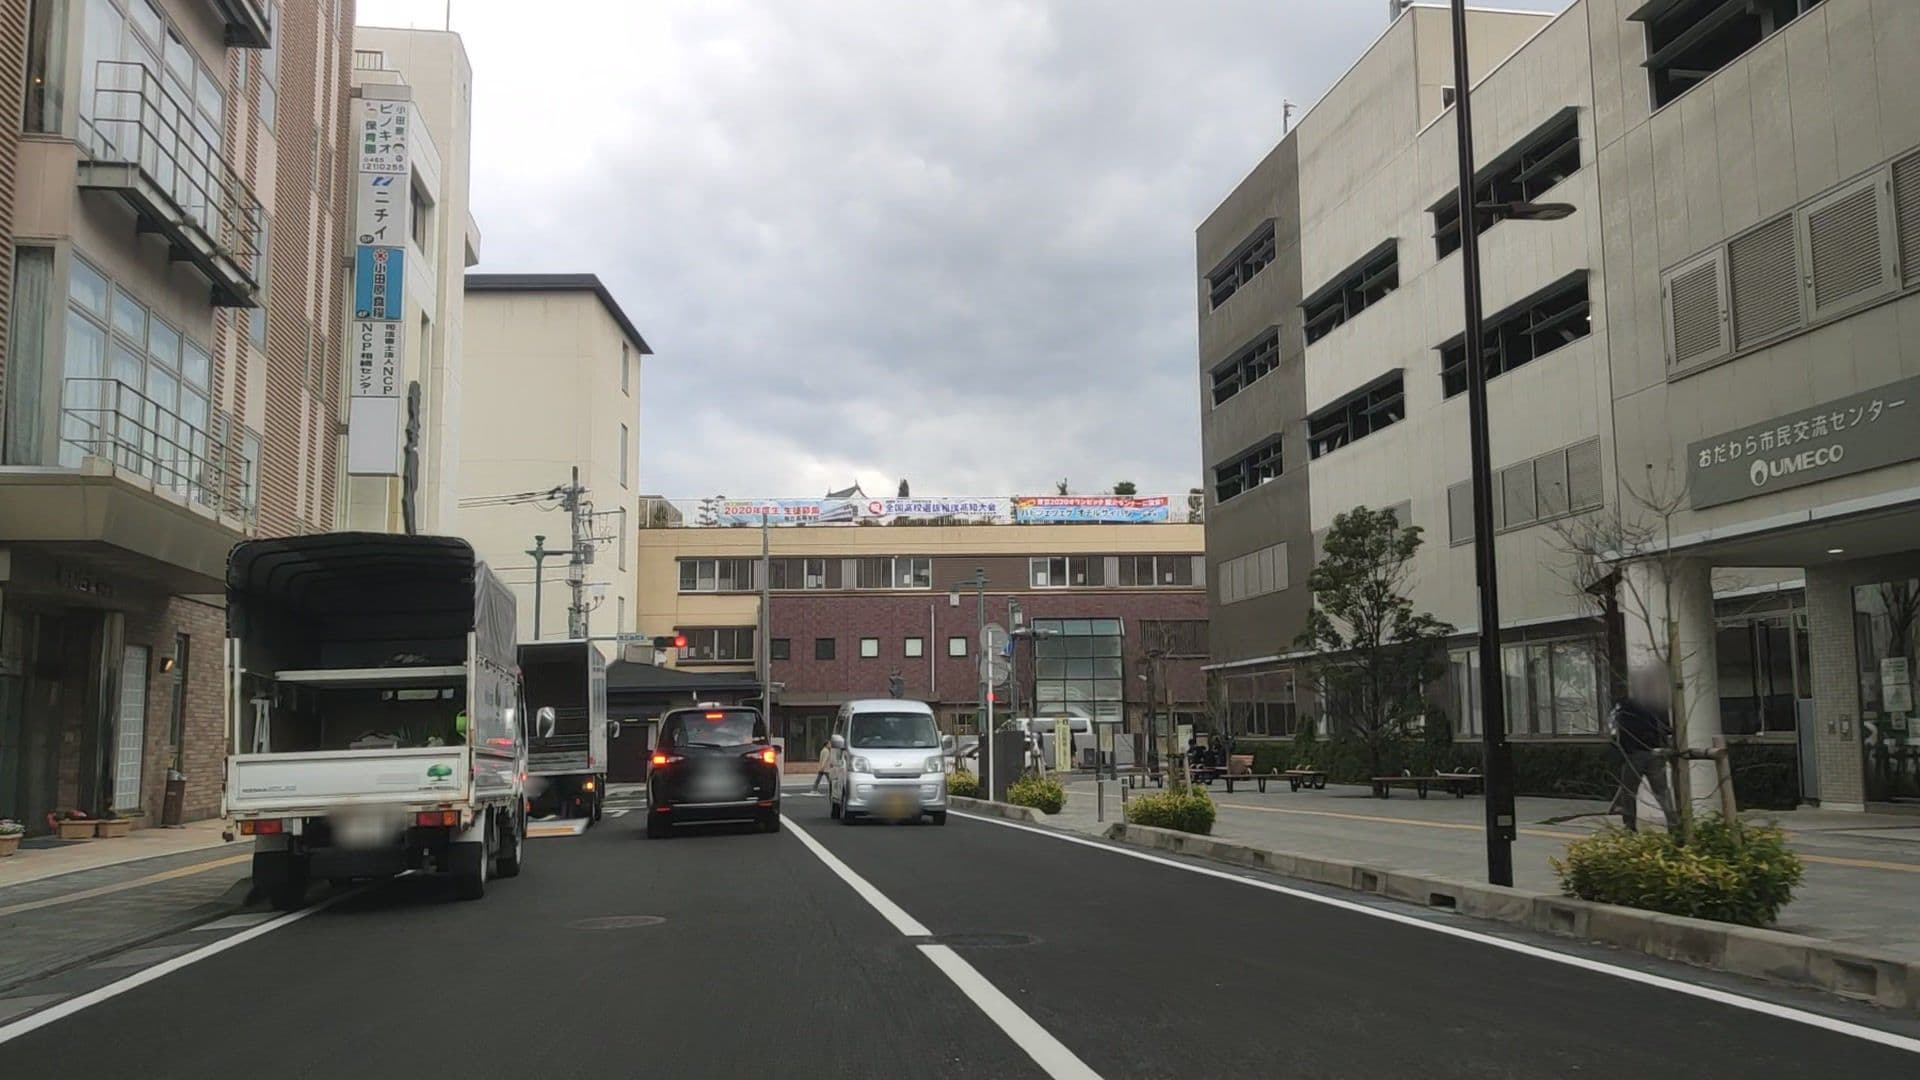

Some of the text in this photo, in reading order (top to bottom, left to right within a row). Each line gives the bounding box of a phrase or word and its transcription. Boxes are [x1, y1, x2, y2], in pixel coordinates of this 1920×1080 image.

[364, 120, 377, 154] 保育園
[379, 103, 394, 154] ピノキオ
[374, 191, 390, 240] ニチイ
[1698, 399, 1906, 468] おだわら市民交流センター
[1770, 444, 1844, 477] UMECO
